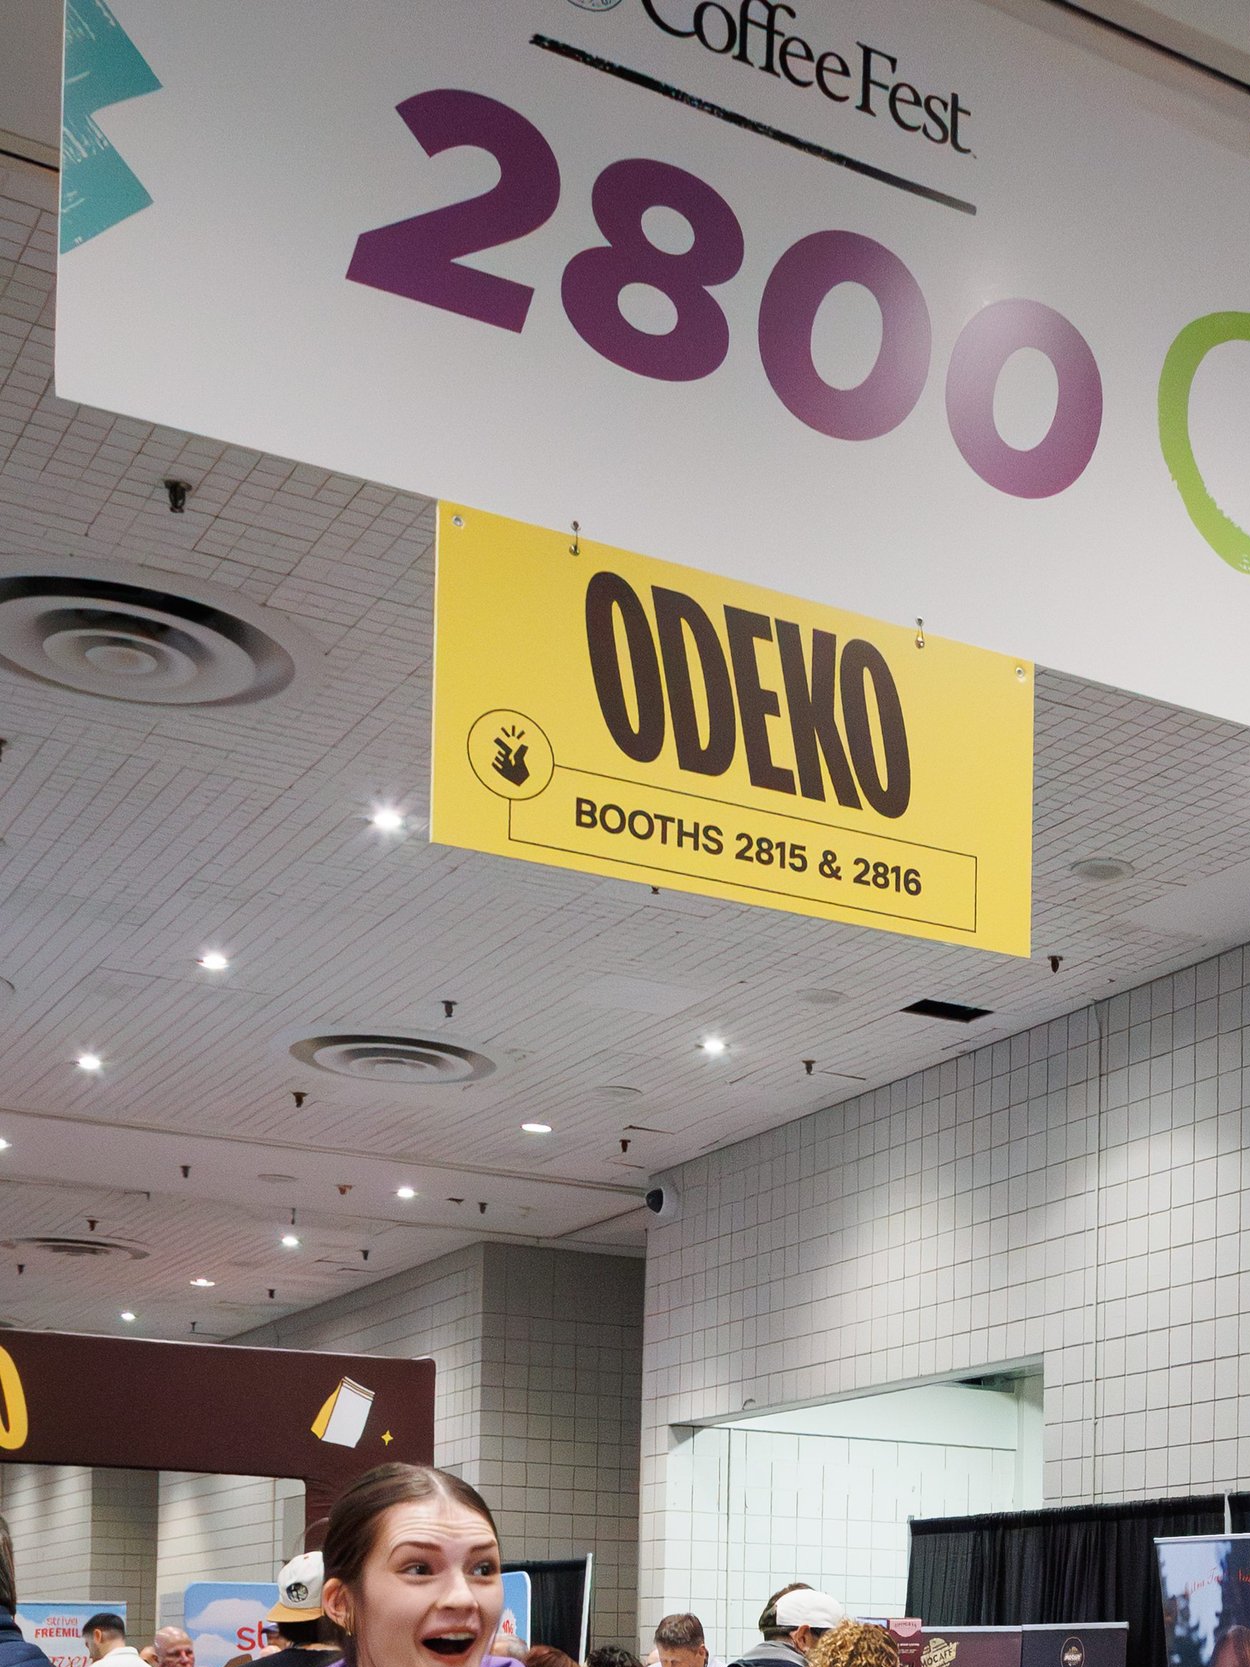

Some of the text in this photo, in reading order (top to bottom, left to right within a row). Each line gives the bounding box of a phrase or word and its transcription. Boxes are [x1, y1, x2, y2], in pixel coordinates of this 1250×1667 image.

[345, 88, 1103, 499] 2800
[585, 570, 912, 819] ODEKO
[575, 797, 923, 897] BOOTHS 2815 & 2816
[34, 1627, 83, 1639] FREEMIL
